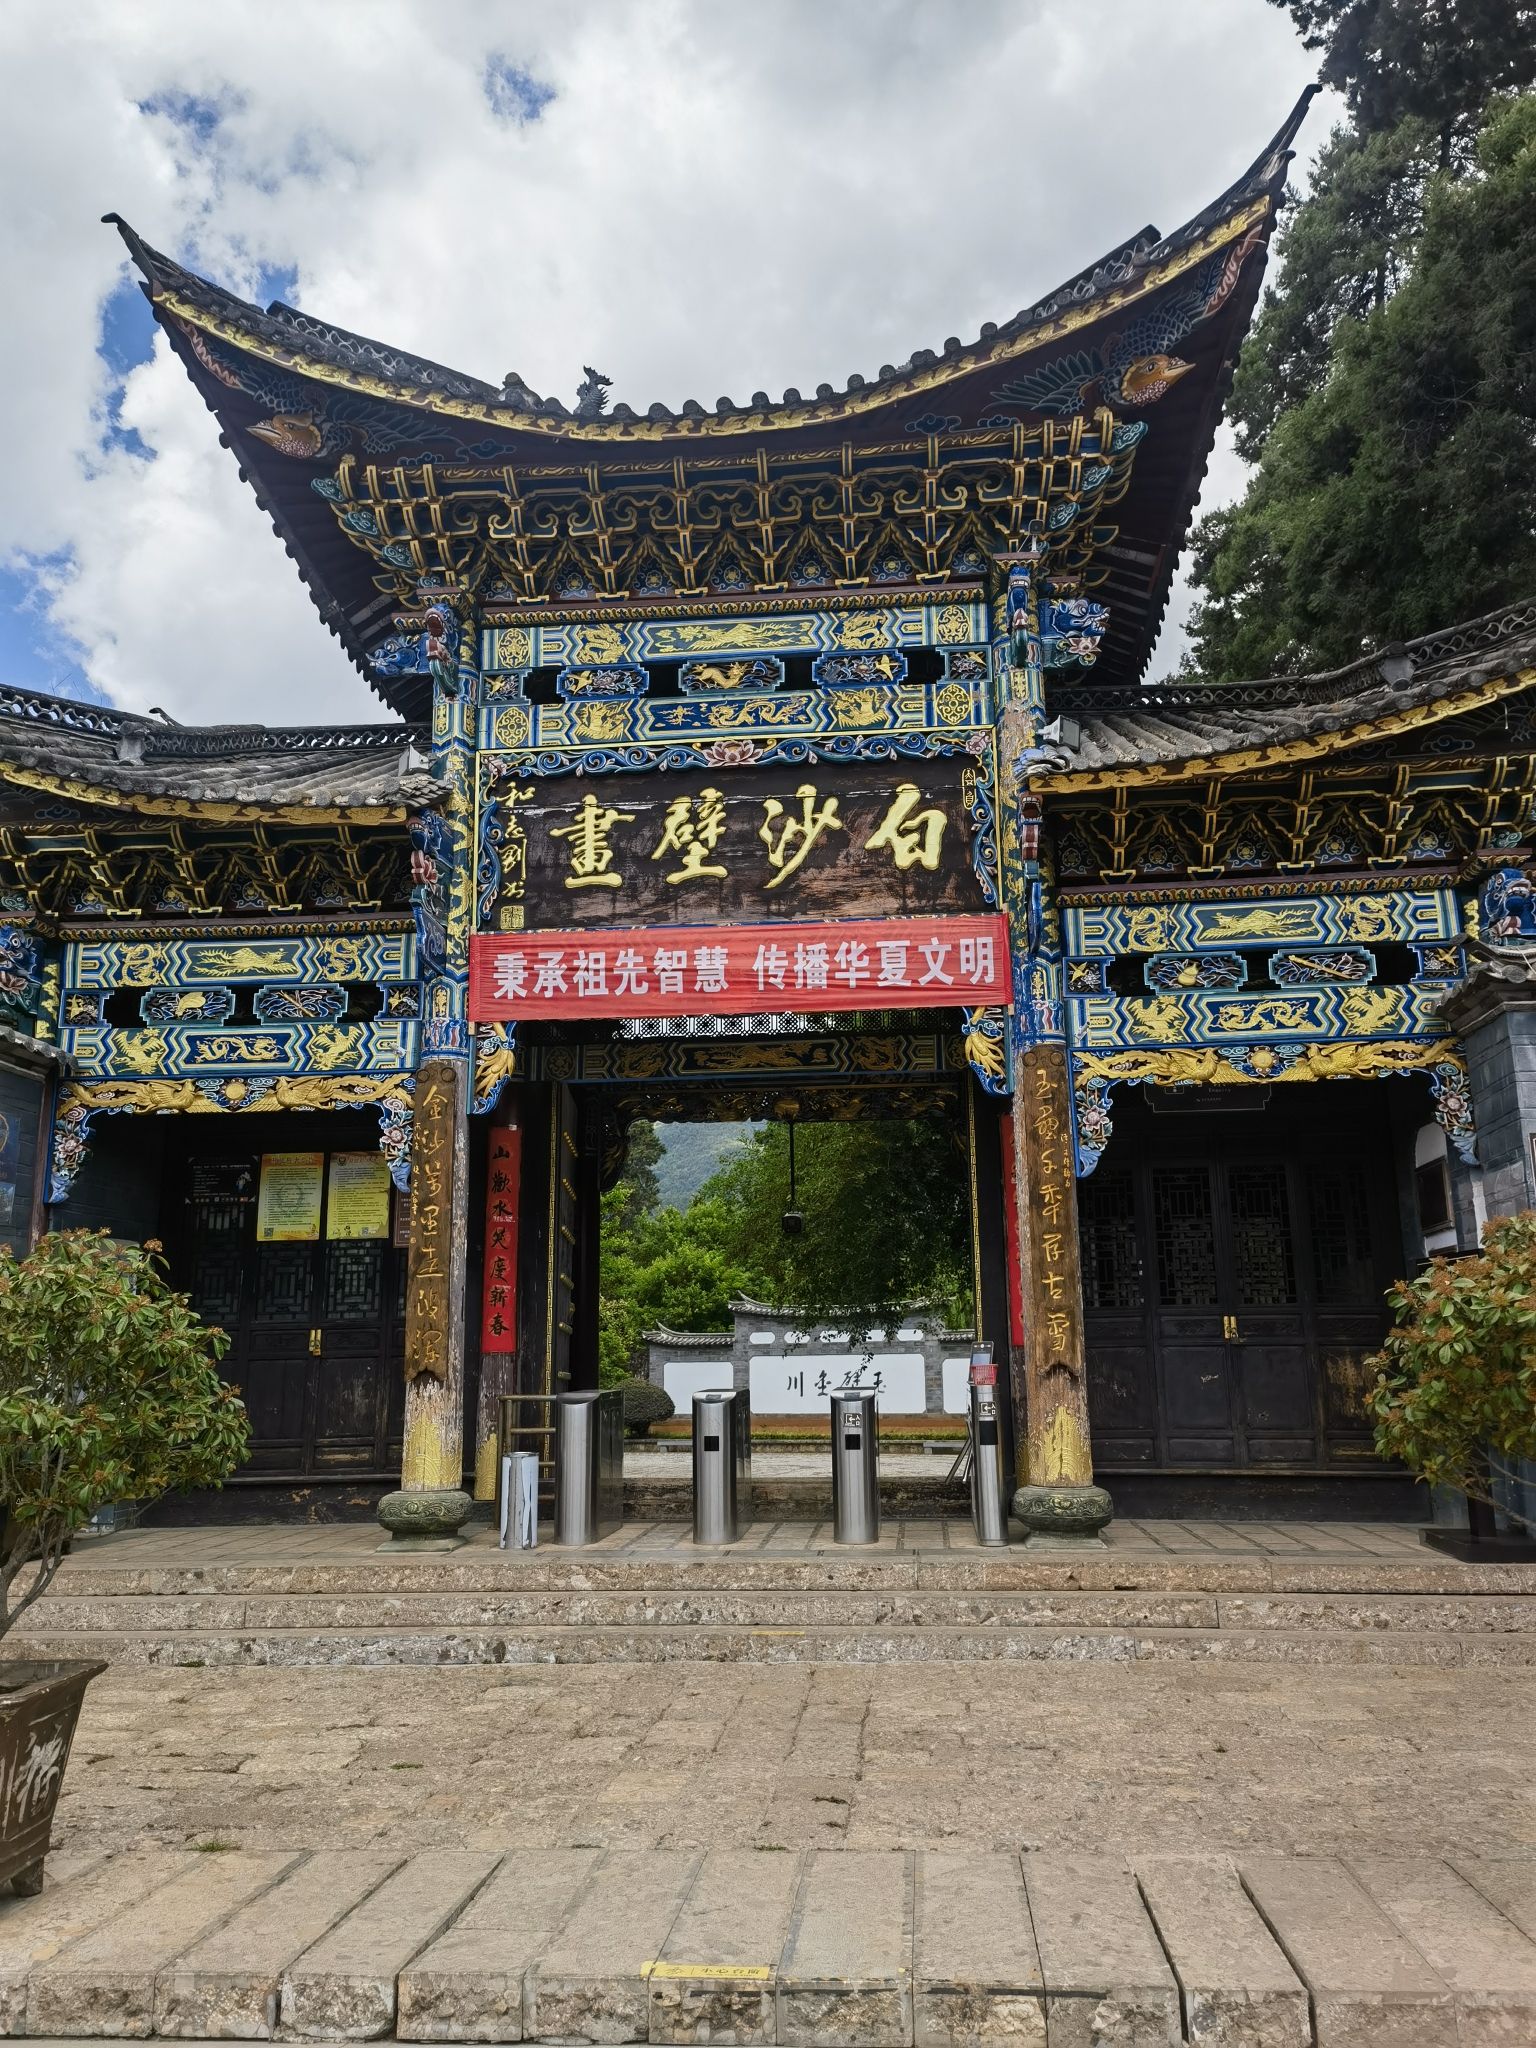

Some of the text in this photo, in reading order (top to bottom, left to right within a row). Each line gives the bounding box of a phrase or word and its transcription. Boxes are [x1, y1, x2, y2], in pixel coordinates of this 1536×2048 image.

[550, 783, 948, 890] 白沙壁畫
[492, 936, 996, 1000] 秉承祖先智慧 传播华夏文明
